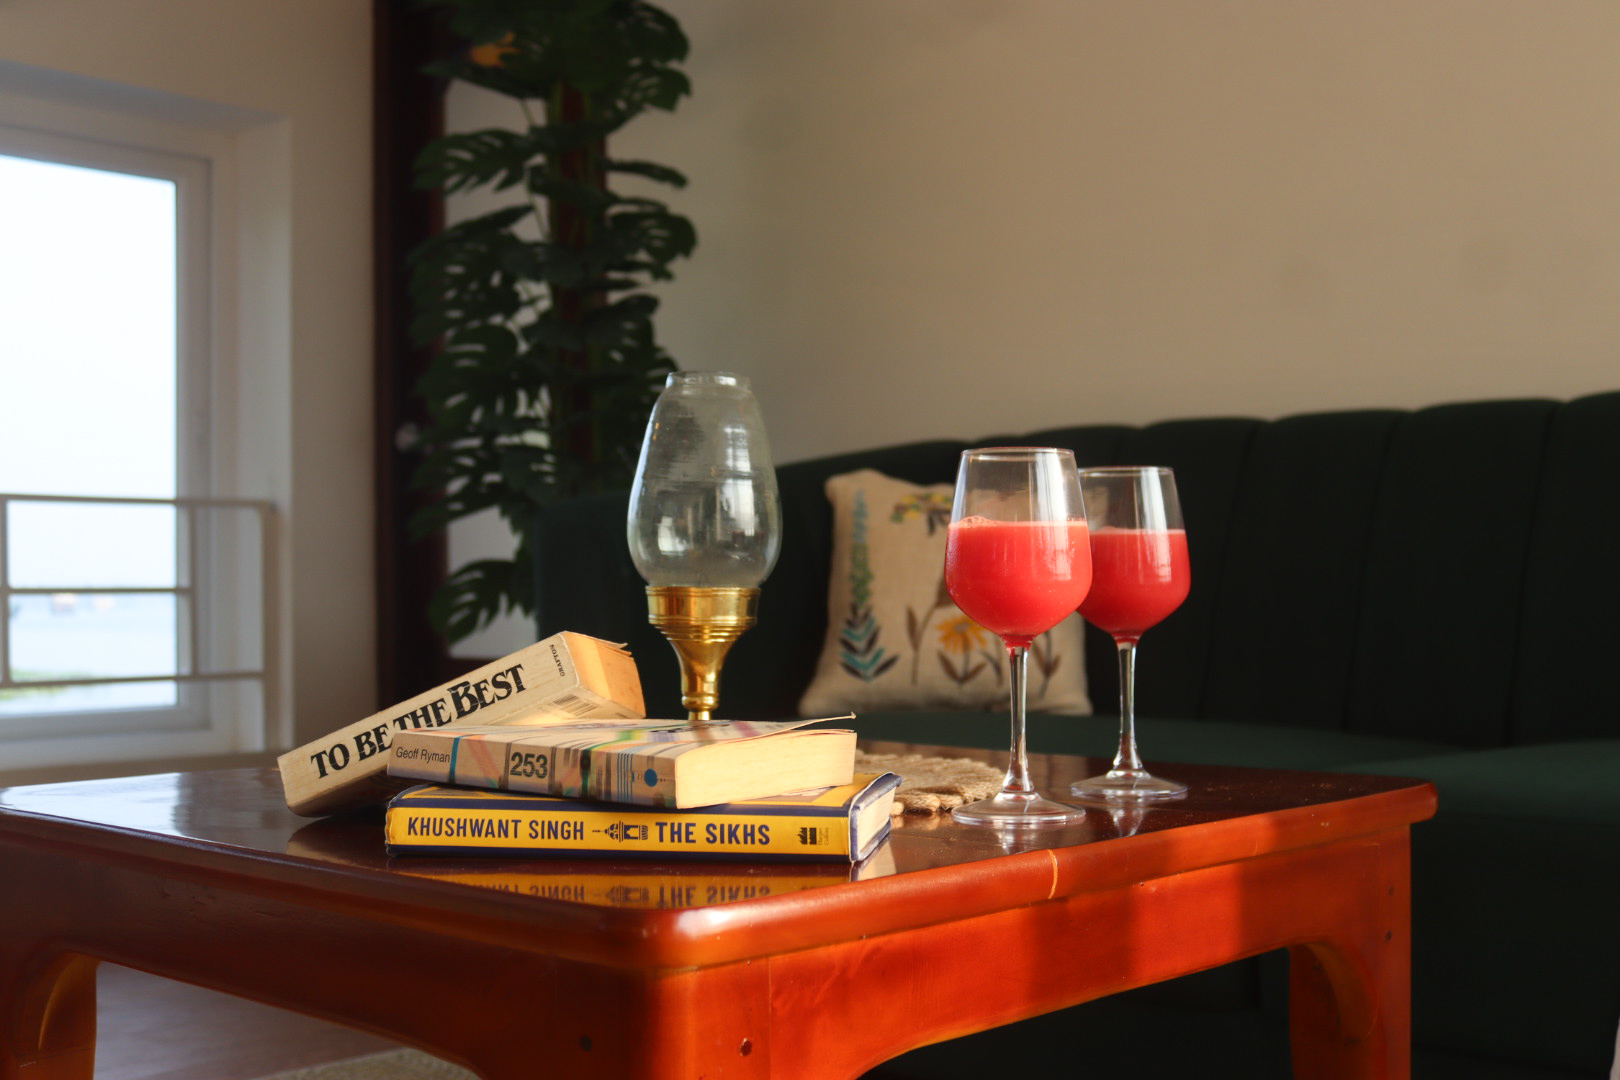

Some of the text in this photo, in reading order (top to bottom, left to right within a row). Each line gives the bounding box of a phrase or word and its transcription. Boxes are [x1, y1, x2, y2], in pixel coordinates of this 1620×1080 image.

[549, 644, 566, 677] GRAFTON
[311, 663, 526, 779] TO BE THE BEST
[395, 746, 451, 766] Geoff Ryman
[509, 751, 548, 779] 253
[407, 816, 585, 842] KHUSHWANT SINGH
[655, 821, 771, 846] THE SIKHS
